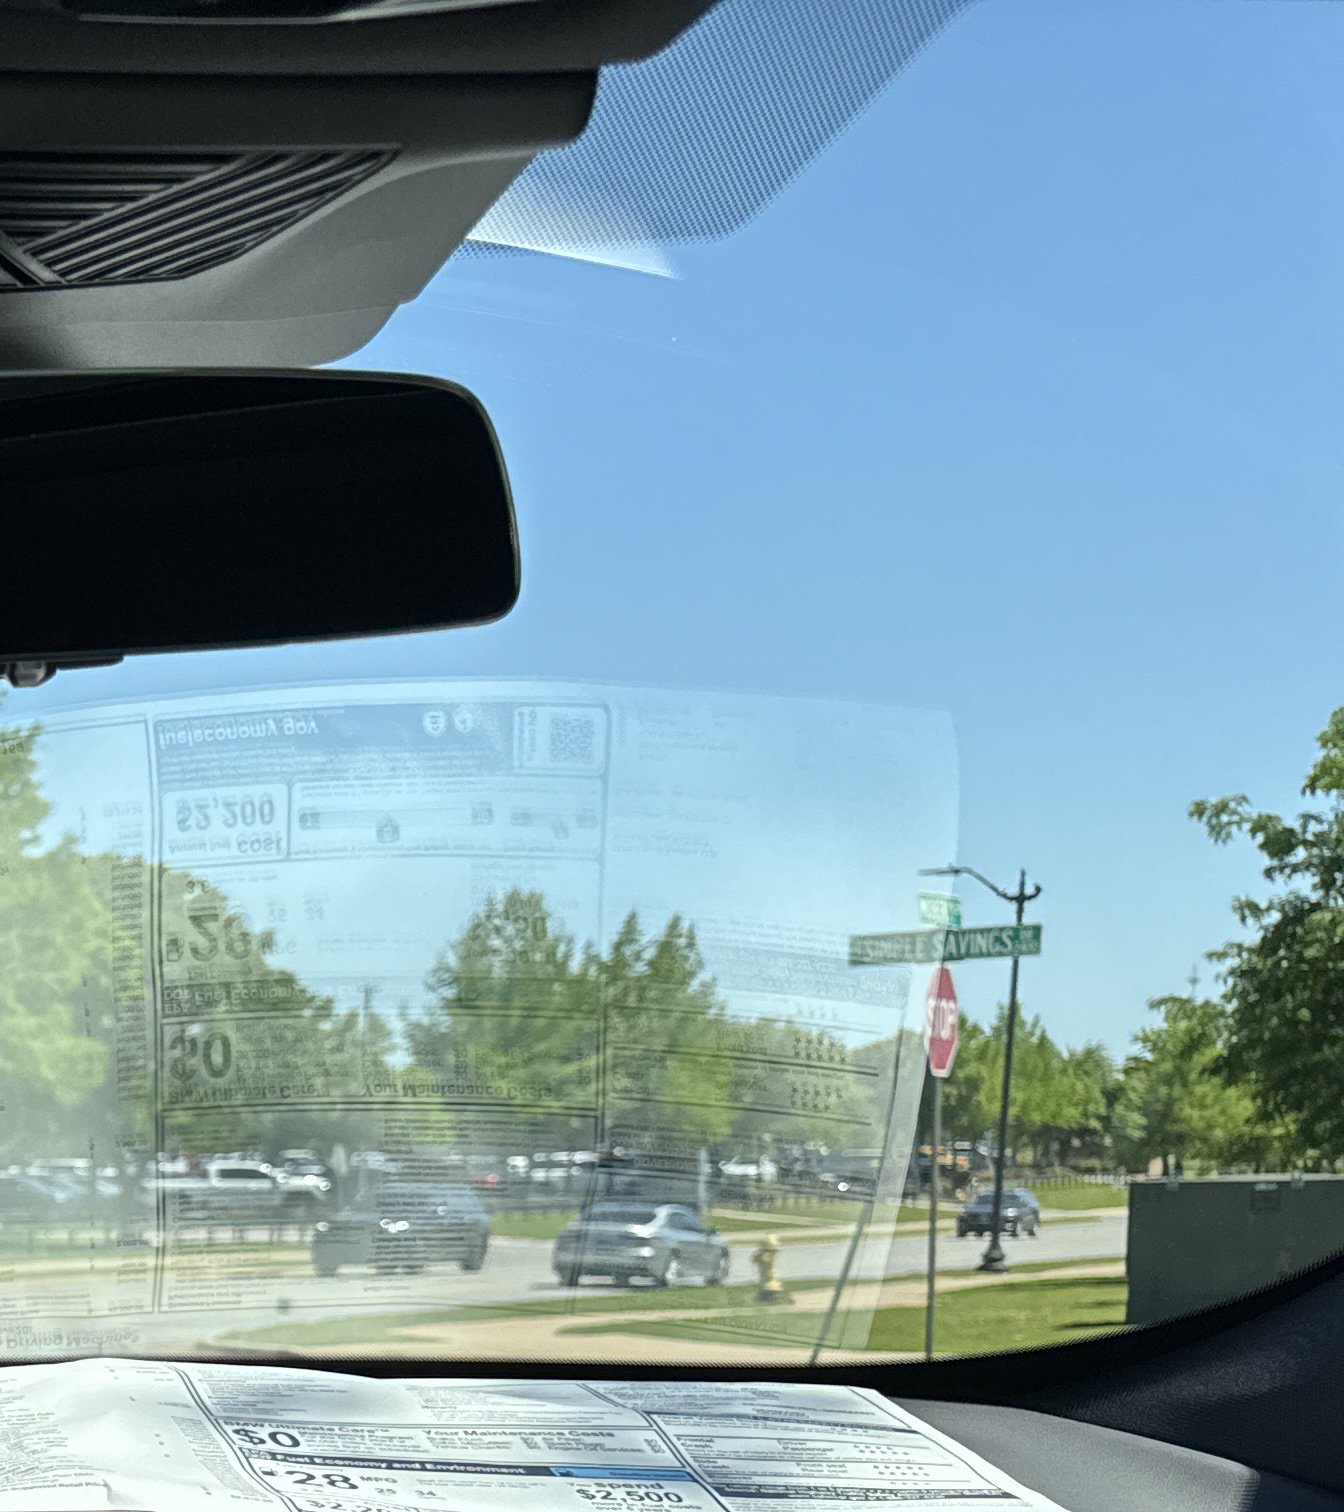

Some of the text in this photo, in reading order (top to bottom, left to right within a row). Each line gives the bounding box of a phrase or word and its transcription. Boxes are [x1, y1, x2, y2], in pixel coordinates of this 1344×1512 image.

[932, 927, 1012, 960] SAVINGS
[927, 997, 957, 1040] STOP
[231, 1428, 301, 1448] $0
[284, 1470, 359, 1490] 28
[575, 1488, 684, 1504] $2,500
